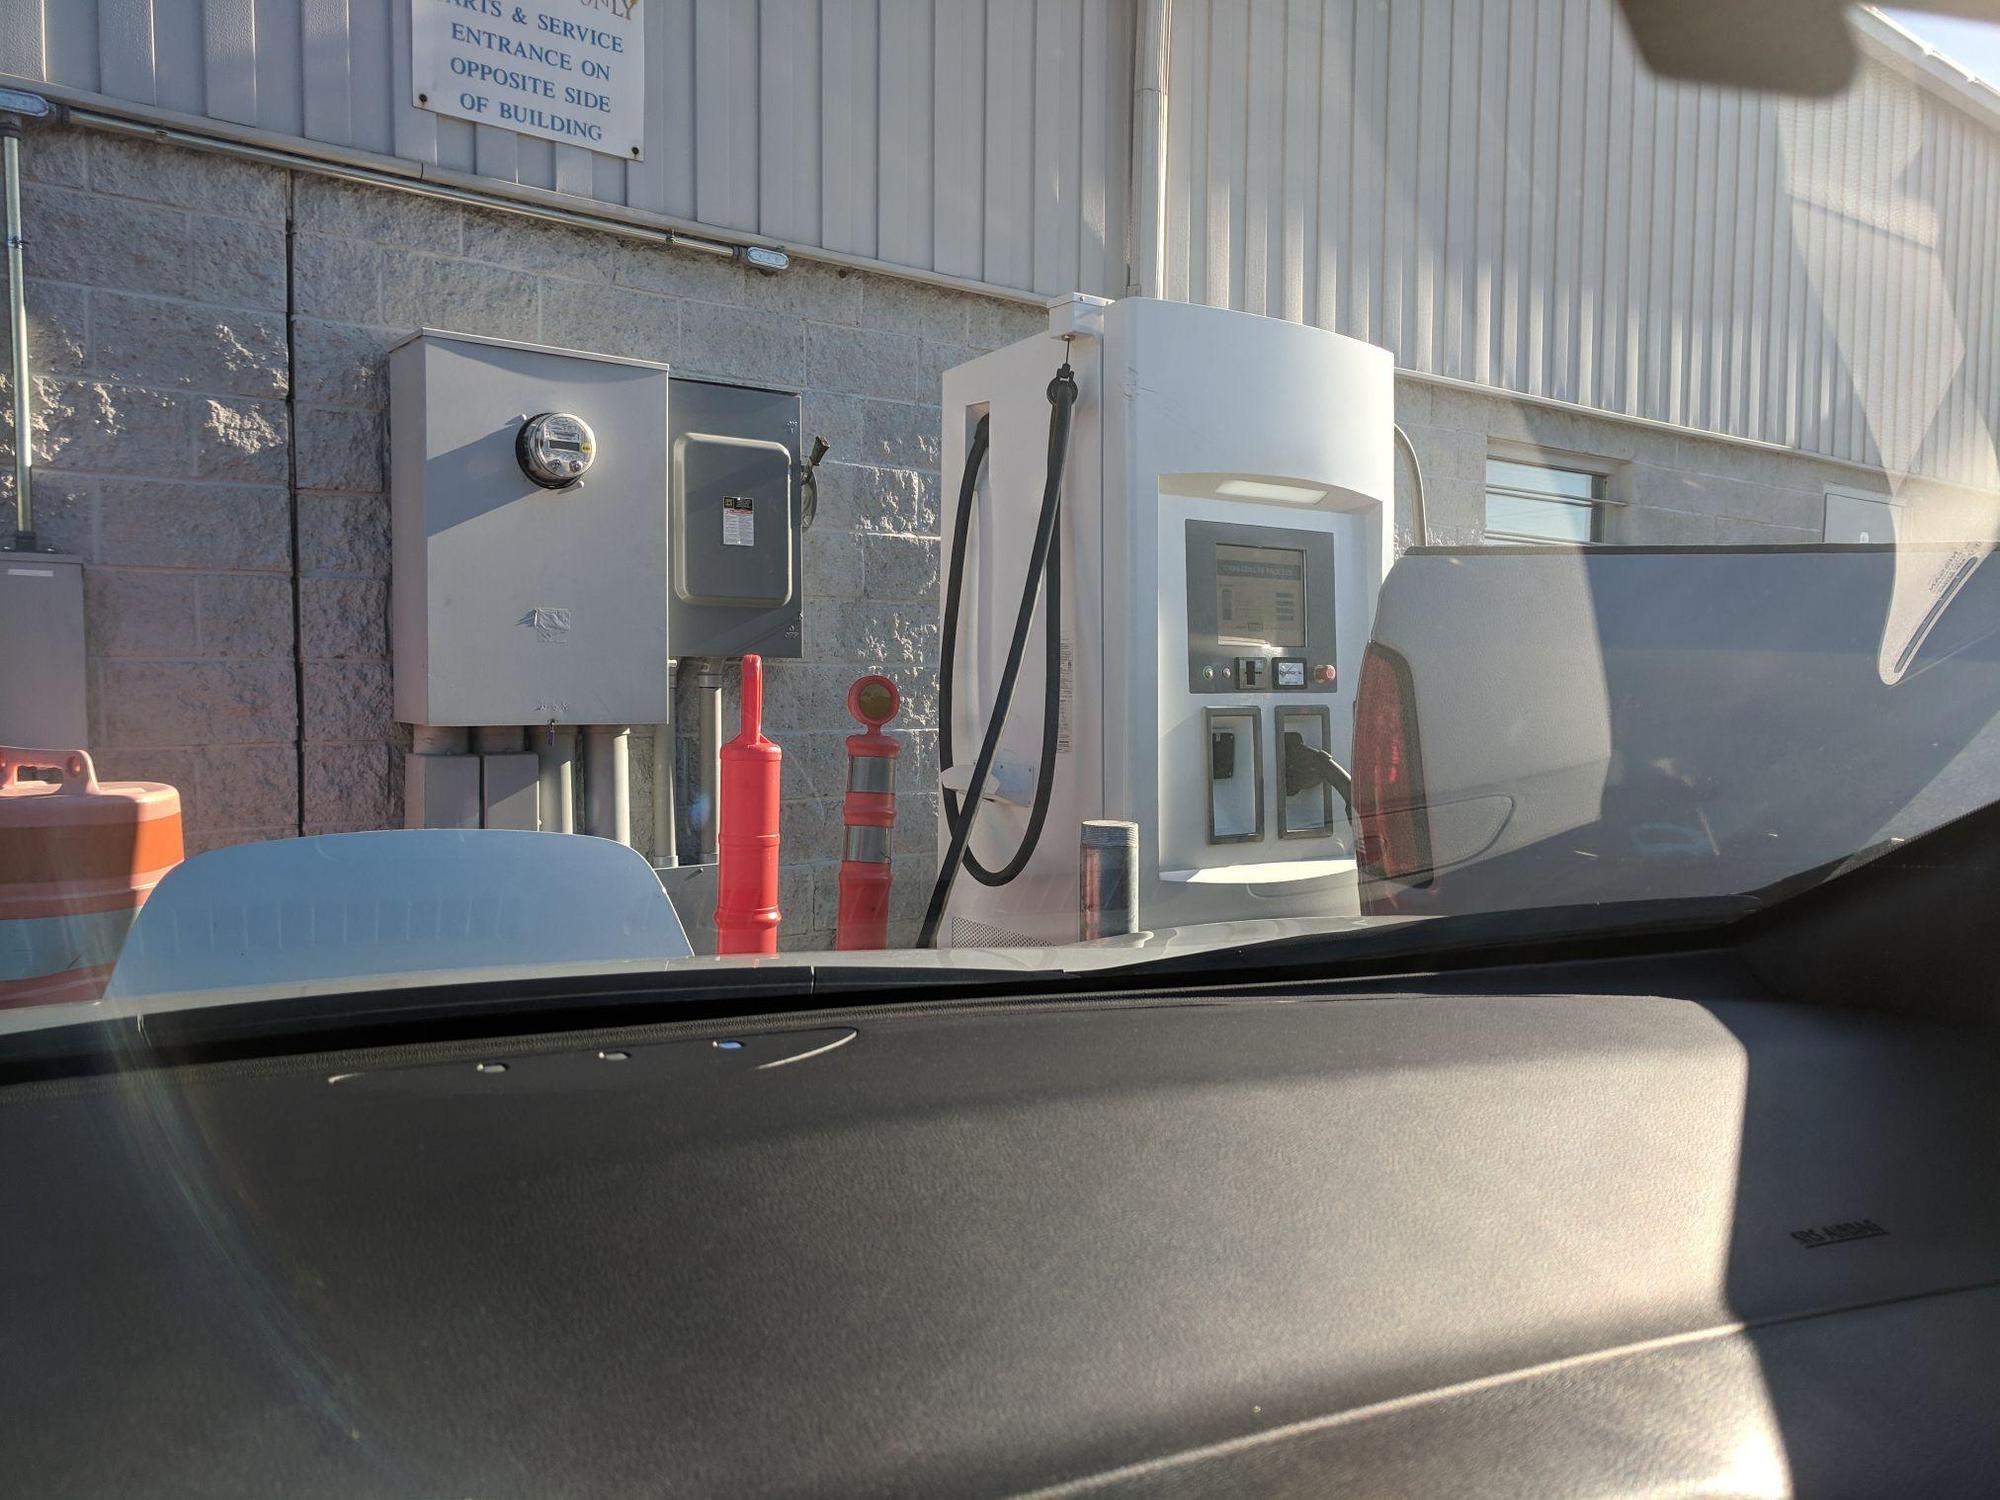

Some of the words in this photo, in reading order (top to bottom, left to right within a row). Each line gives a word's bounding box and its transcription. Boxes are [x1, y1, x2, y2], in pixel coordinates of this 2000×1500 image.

[446, 0, 502, 17] RTS
[512, 6, 528, 25] &
[538, 14, 624, 53] SERVICE
[451, 22, 573, 71] ENTRANCE
[582, 60, 611, 81] ON
[451, 57, 556, 98] OPPOSITE
[565, 86, 611, 113] SIDE
[460, 93, 489, 113] OF
[500, 101, 603, 141] BUILDING
